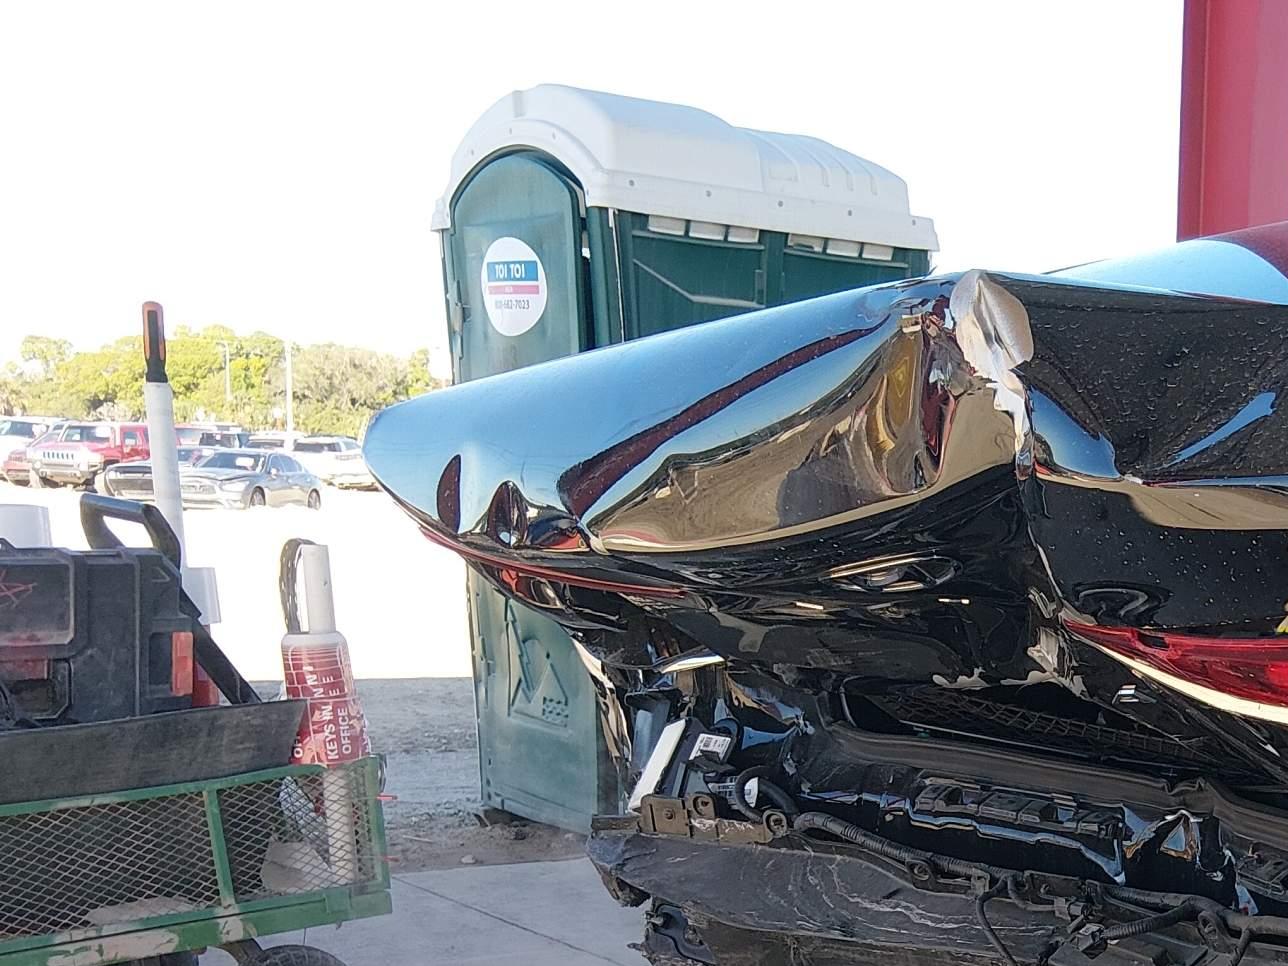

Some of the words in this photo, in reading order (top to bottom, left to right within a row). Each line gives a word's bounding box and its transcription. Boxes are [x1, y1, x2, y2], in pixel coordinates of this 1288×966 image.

[495, 263, 507, 279] TOI
[509, 263, 525, 279] TOI
[321, 704, 334, 721] IN
[324, 723, 339, 760] KEYS
[338, 707, 351, 754] OFFICE
